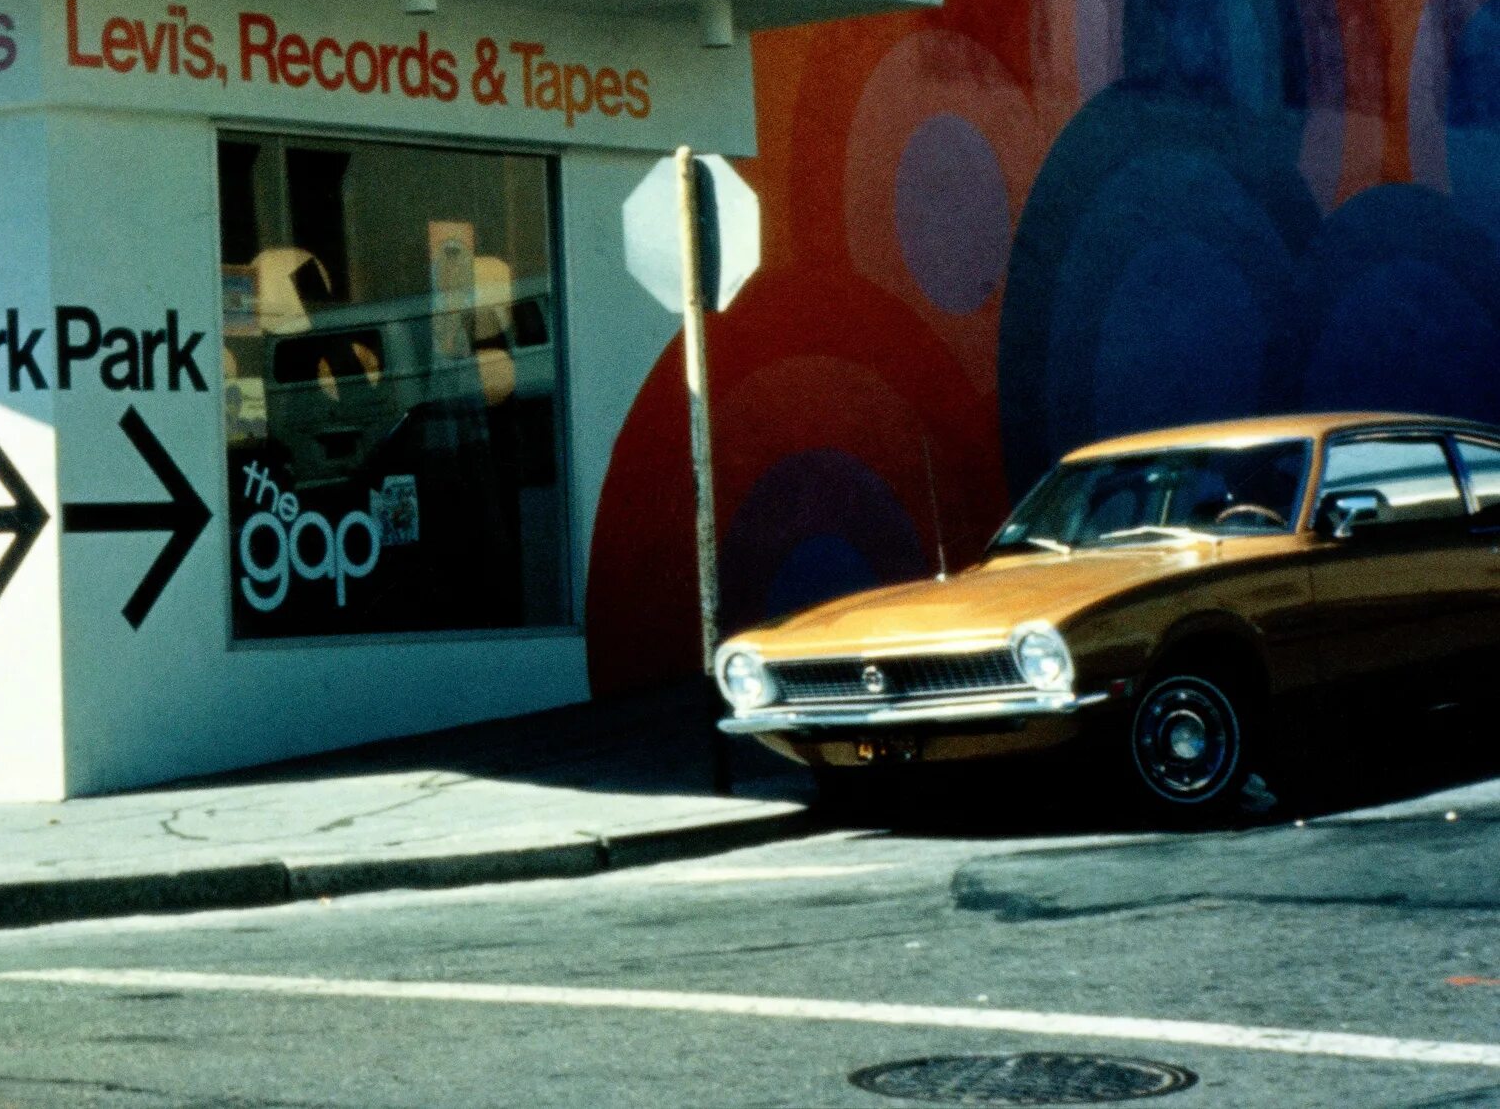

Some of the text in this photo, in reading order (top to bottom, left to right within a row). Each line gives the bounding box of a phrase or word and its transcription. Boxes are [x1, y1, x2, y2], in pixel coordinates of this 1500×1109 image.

[238, 11, 460, 102] Records
[469, 36, 508, 107] &
[510, 42, 652, 128] Tapes
[55, 305, 209, 392] Park
[242, 460, 299, 522] the
[240, 510, 381, 612] gap
